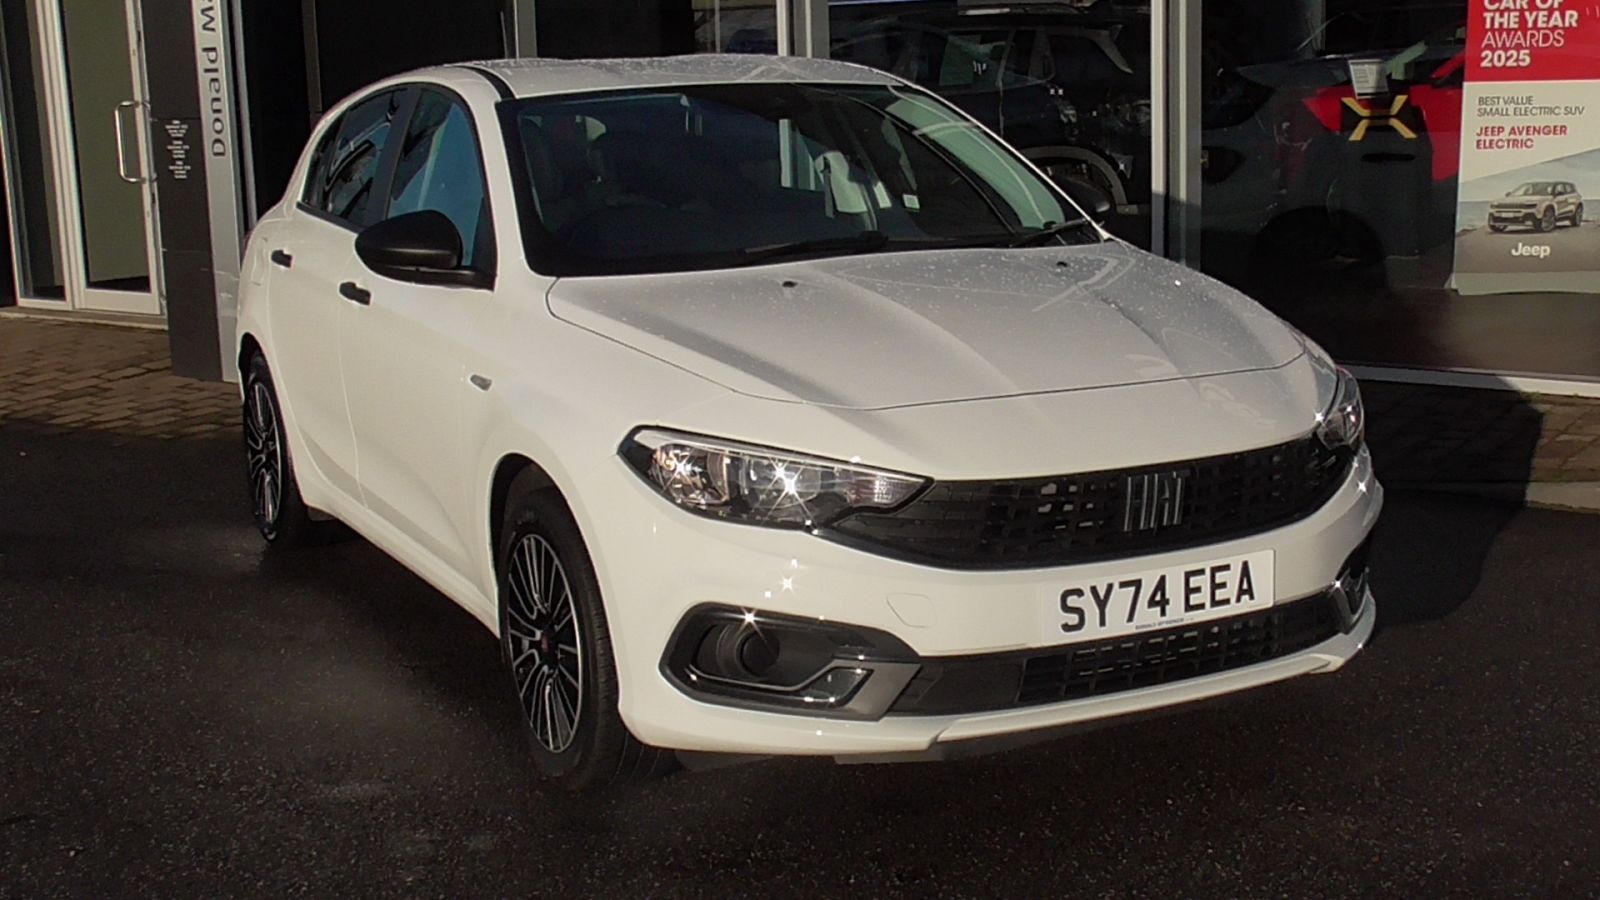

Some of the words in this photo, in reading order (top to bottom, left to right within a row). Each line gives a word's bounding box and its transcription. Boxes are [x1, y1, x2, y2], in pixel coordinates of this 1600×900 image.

[1484, 0, 1528, 10] CAR
[200, 0, 216, 32] M
[1483, 11, 1520, 29] THE
[1524, 10, 1579, 28] YEAR
[1481, 30, 1565, 48] AWARDS
[1480, 50, 1531, 67] 2025
[202, 47, 226, 157] Donald
[1478, 96, 1501, 106] BEST
[1502, 96, 1534, 106] VALUE
[1477, 107, 1510, 117] SMALL
[1513, 106, 1561, 116] ELECTRIC
[1563, 106, 1585, 115] SUV
[1476, 126, 1505, 137] JEEP
[1508, 125, 1568, 136] AVENGER
[1475, 138, 1534, 150] ELECTRIC
[1511, 242, 1551, 259] Jeep
[1060, 574, 1170, 633] SY74
[1184, 560, 1255, 613] EEA
